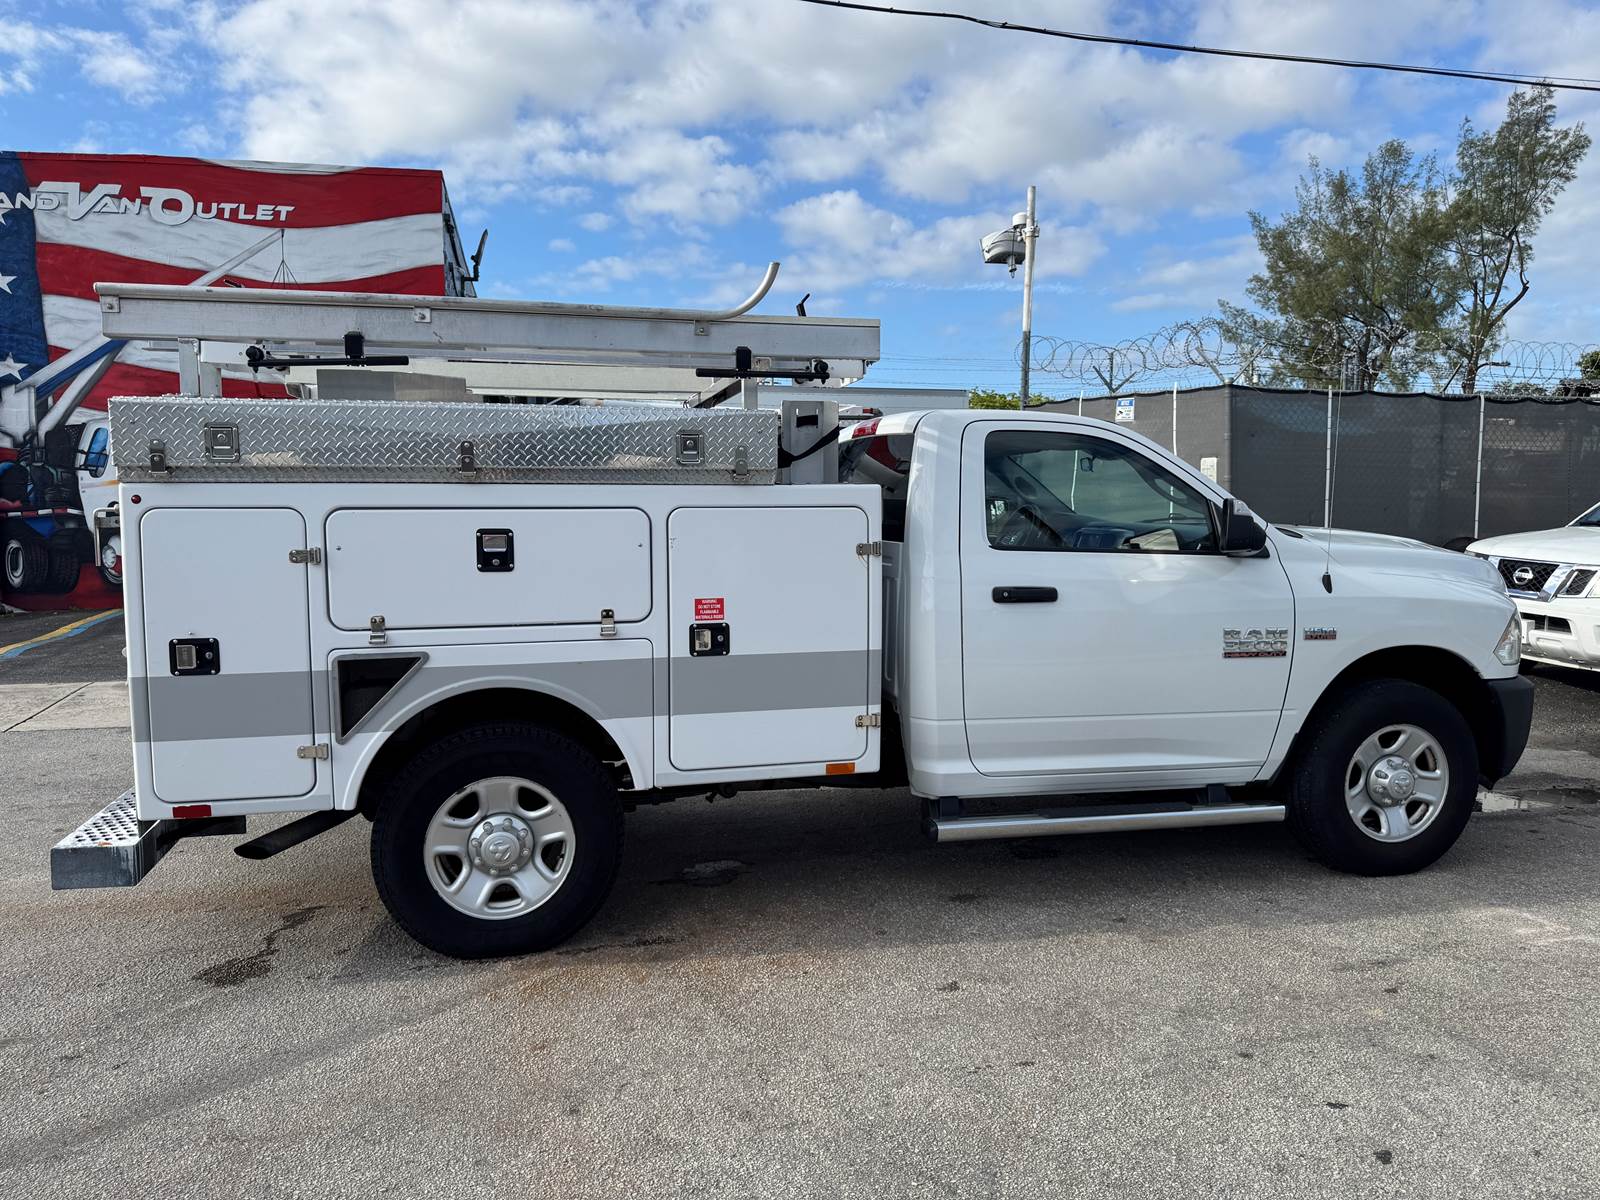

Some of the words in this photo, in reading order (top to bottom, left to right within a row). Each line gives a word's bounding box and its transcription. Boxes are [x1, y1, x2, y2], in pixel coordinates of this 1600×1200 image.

[36, 181, 142, 220] VAN
[140, 186, 295, 226] OUTLET
[1223, 628, 1288, 640] RAM
